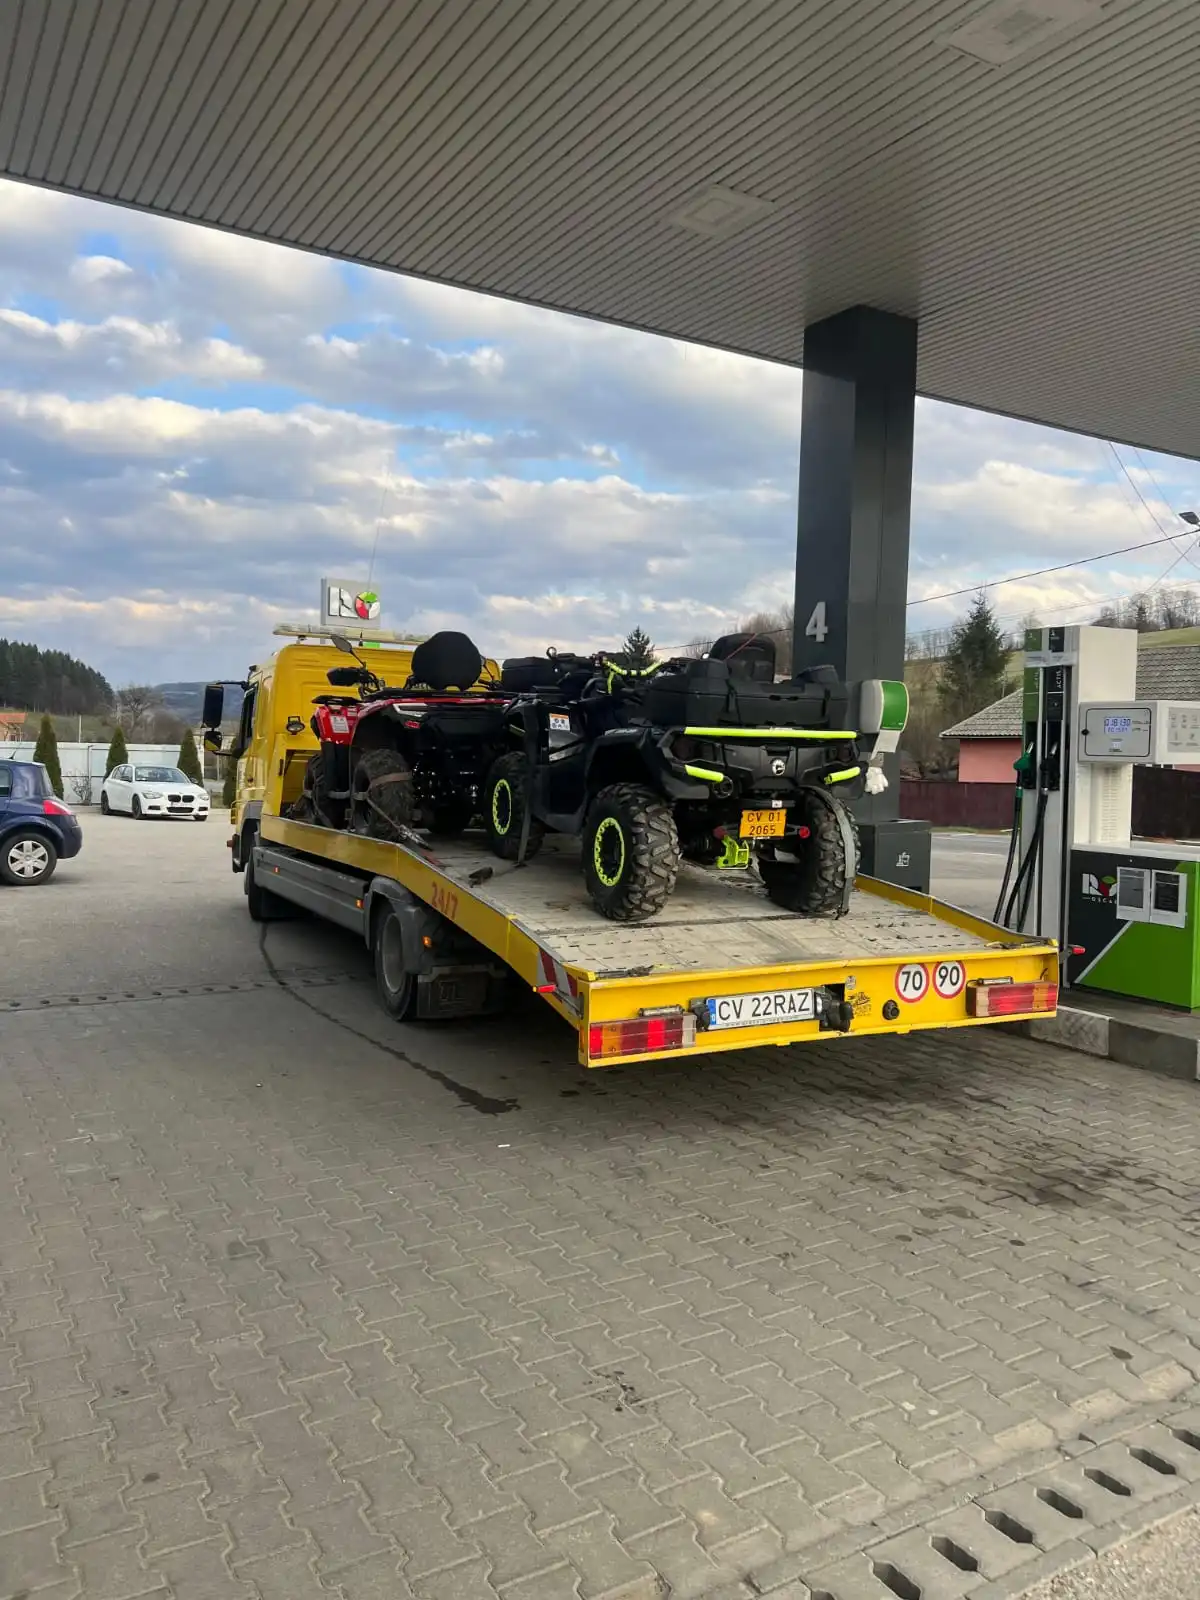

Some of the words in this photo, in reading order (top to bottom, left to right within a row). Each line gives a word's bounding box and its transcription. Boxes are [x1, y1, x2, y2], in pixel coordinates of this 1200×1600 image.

[805, 601, 829, 643] 4
[747, 812, 762, 823] CV
[768, 811, 781, 822] 01
[749, 825, 776, 836] 2065
[901, 970, 923, 992] 70
[938, 965, 960, 988] 90
[718, 999, 744, 1021] CV
[751, 992, 810, 1017] 22RAZ
